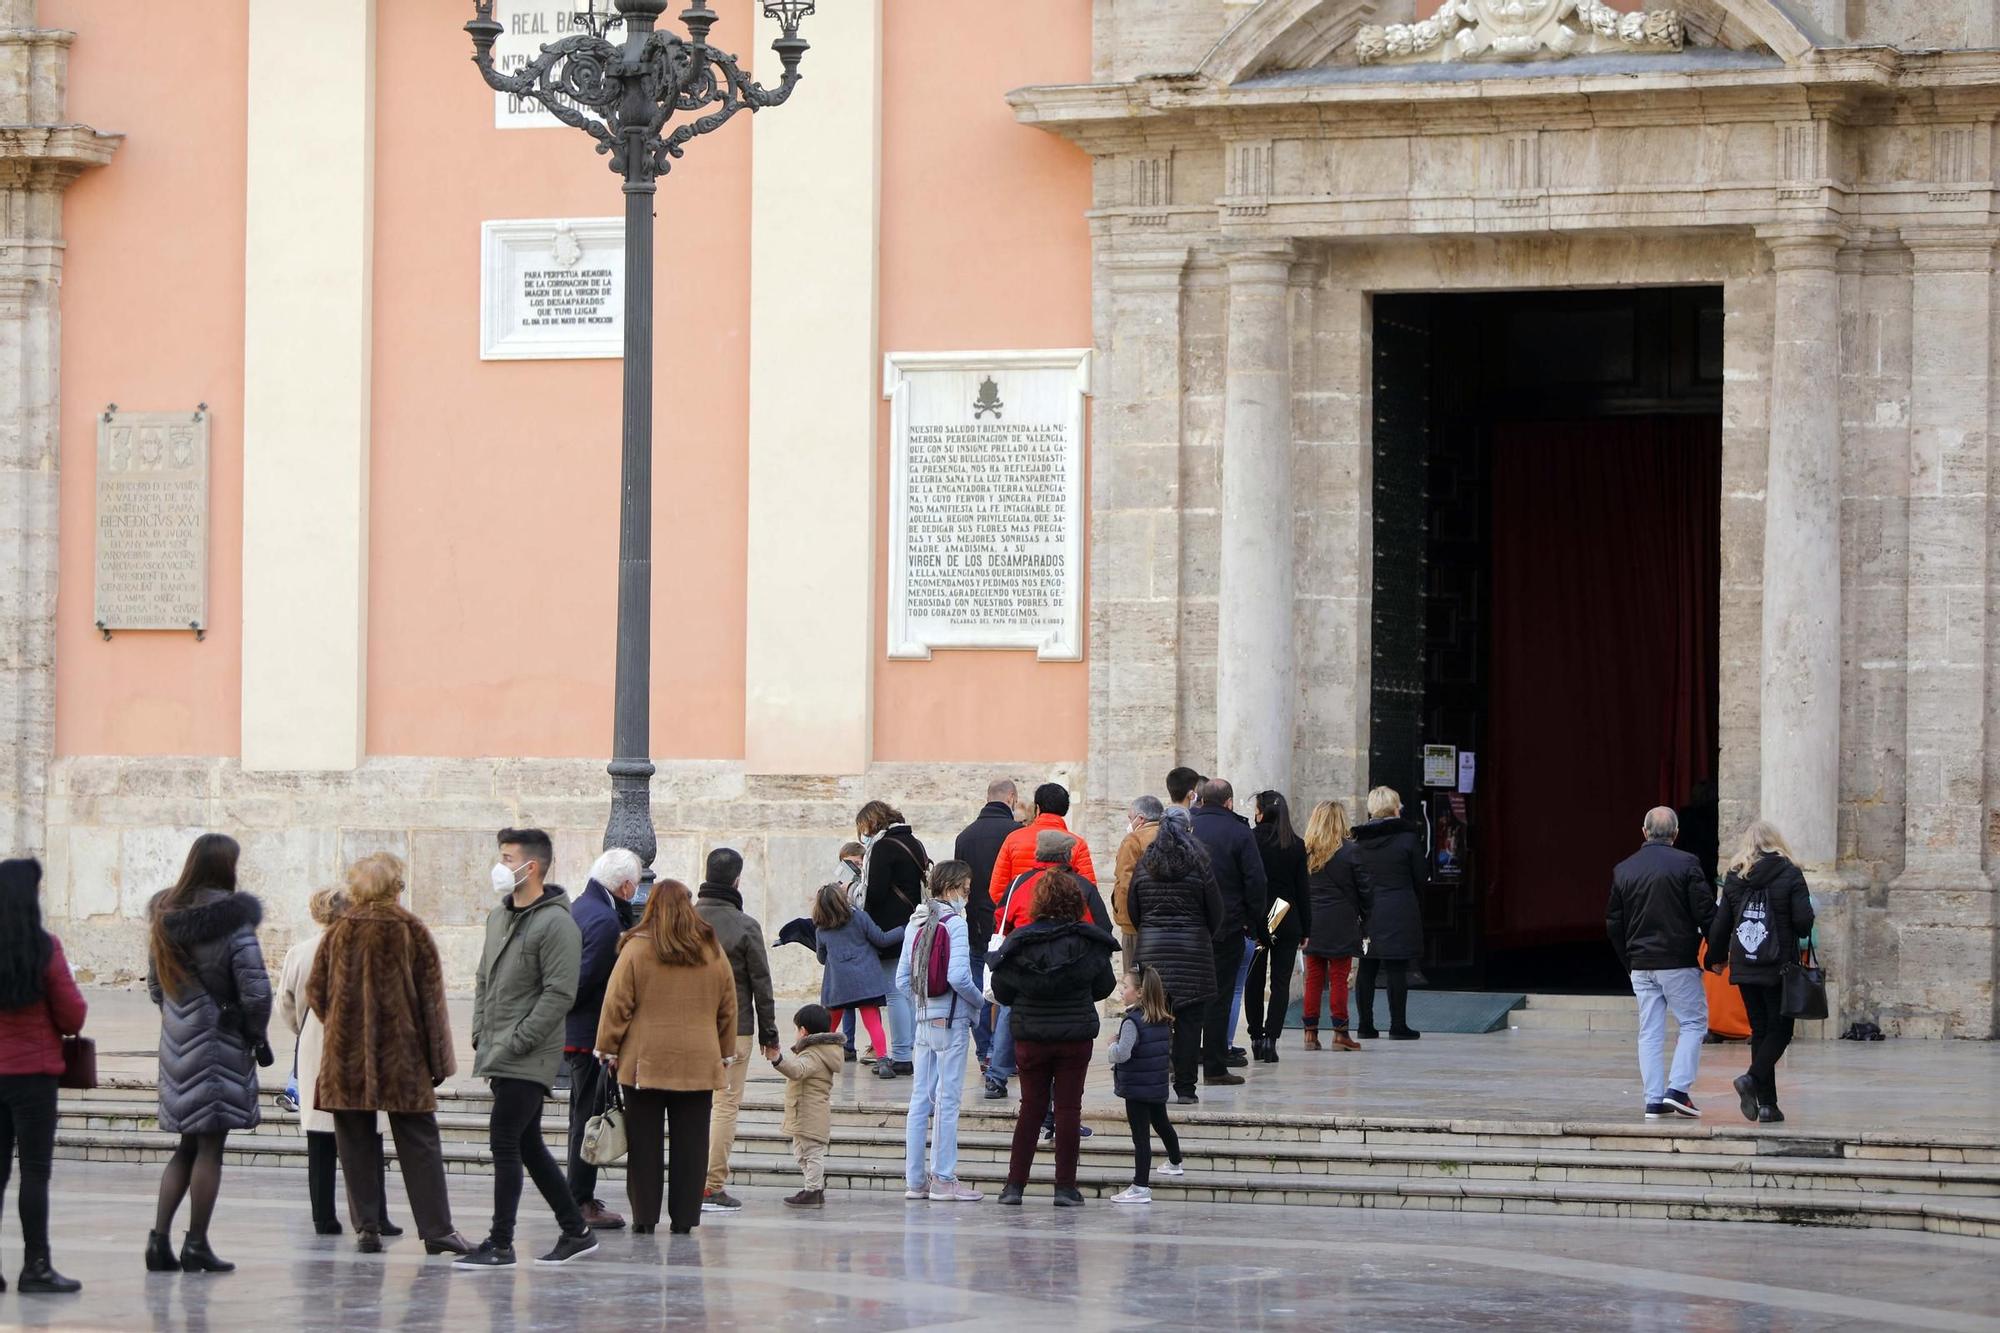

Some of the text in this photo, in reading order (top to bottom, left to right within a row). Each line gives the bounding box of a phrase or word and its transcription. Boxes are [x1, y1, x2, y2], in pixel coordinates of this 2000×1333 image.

[512, 13, 549, 35] REAL
[536, 280, 545, 288] LA
[603, 279, 611, 287] LA
[552, 289, 562, 297] DE
[602, 288, 611, 296] DE
[531, 298, 604, 307] LOS DESAMPARADOS
[977, 425, 981, 433] Y
[983, 425, 1030, 433] BIENVENIDA
[1012, 435, 1022, 443] DE
[910, 446, 924, 454] QUE
[991, 445, 1028, 453] PRELADO
[960, 455, 1006, 463] BULLICIOSA
[1008, 455, 1012, 463] Y
[971, 465, 986, 473] NOS
[990, 465, 1000, 473] HA
[1055, 464, 1065, 472] LA
[966, 475, 971, 483] Y
[974, 475, 983, 483] LA
[987, 475, 1001, 483] LUZ
[937, 485, 990, 493] ENCANTADORA
[956, 495, 985, 503] FERVOR
[989, 495, 994, 503] Y
[927, 505, 973, 513] MANIFIESTA
[977, 505, 986, 513] LA
[990, 505, 1000, 513] FE
[178, 515, 199, 527] XVI
[946, 515, 974, 523] REGION
[958, 525, 972, 533] SUS
[977, 525, 1007, 533] FLORES
[1011, 525, 1029, 533] MAS
[928, 535, 932, 543] Y
[937, 535, 951, 543] SUS
[957, 535, 996, 543] MEJORES
[1001, 535, 1040, 543] SONRISAS
[909, 545, 939, 553] MADRE
[908, 555, 1064, 567] VIRGEN DE LOS DESAMPARADOS
[909, 569, 913, 577] A
[1055, 569, 1064, 577] OS
[908, 579, 974, 587] ENCOMENDAMOS
[976, 579, 980, 587] Y
[983, 579, 1019, 587] PEDIMOS
[1022, 579, 1037, 587] NOS
[950, 589, 1009, 597] AGRADECIENDO
[1012, 589, 1047, 597] VUESTRA
[908, 599, 951, 607] NEROSIDAD
[955, 599, 969, 607] CON
[974, 599, 1013, 607] NUESTROS
[1053, 599, 1064, 607] DE
[908, 609, 928, 617] TODO
[931, 609, 967, 617] CORAZON
[970, 609, 980, 617] OS
